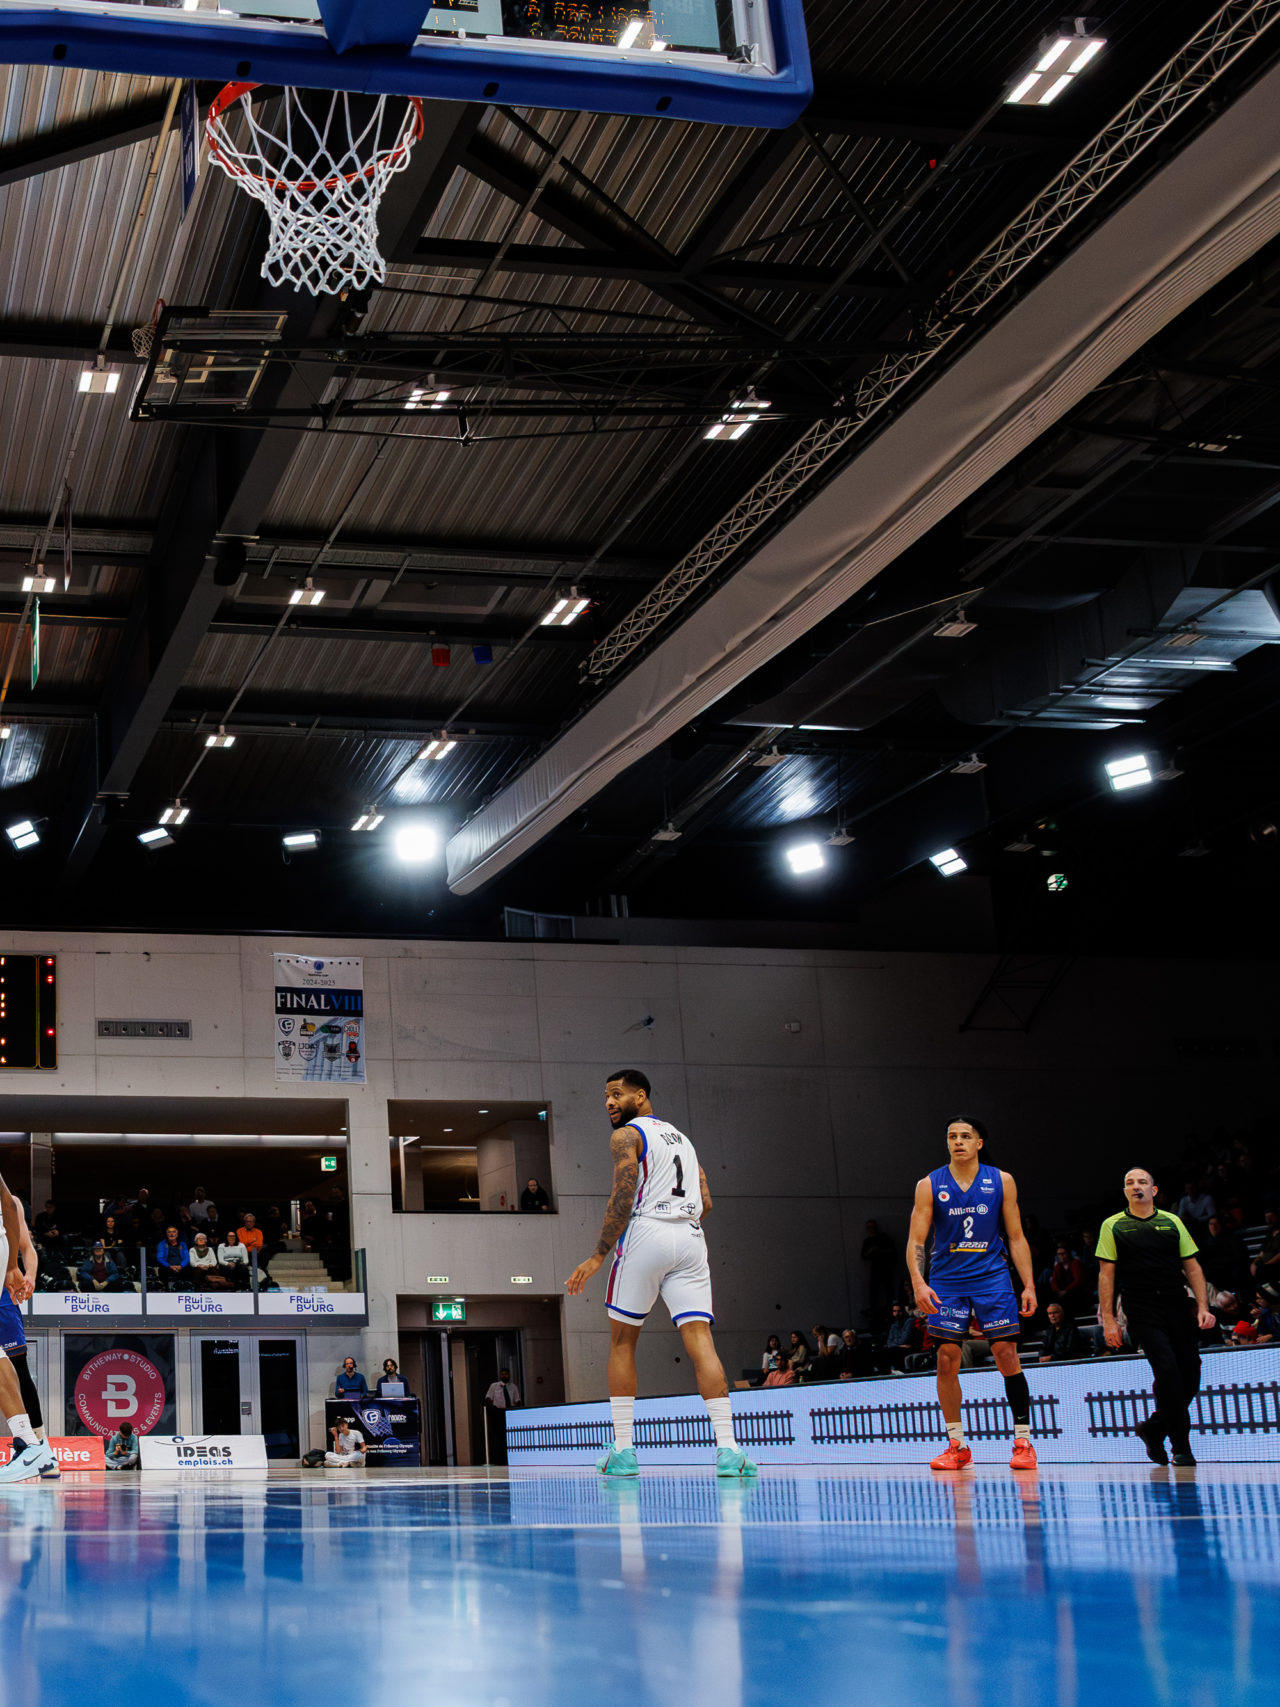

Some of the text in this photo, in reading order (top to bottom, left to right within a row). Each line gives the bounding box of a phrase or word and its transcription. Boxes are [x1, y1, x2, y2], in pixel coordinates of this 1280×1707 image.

[276, 992, 331, 1010] FINAL
[671, 1154, 686, 1198] 1
[963, 1216, 974, 1239] 2
[129, 1354, 157, 1380] STUDIO
[145, 1392, 162, 1425] EVENTS
[178, 1458, 233, 1467] emplois.ch
